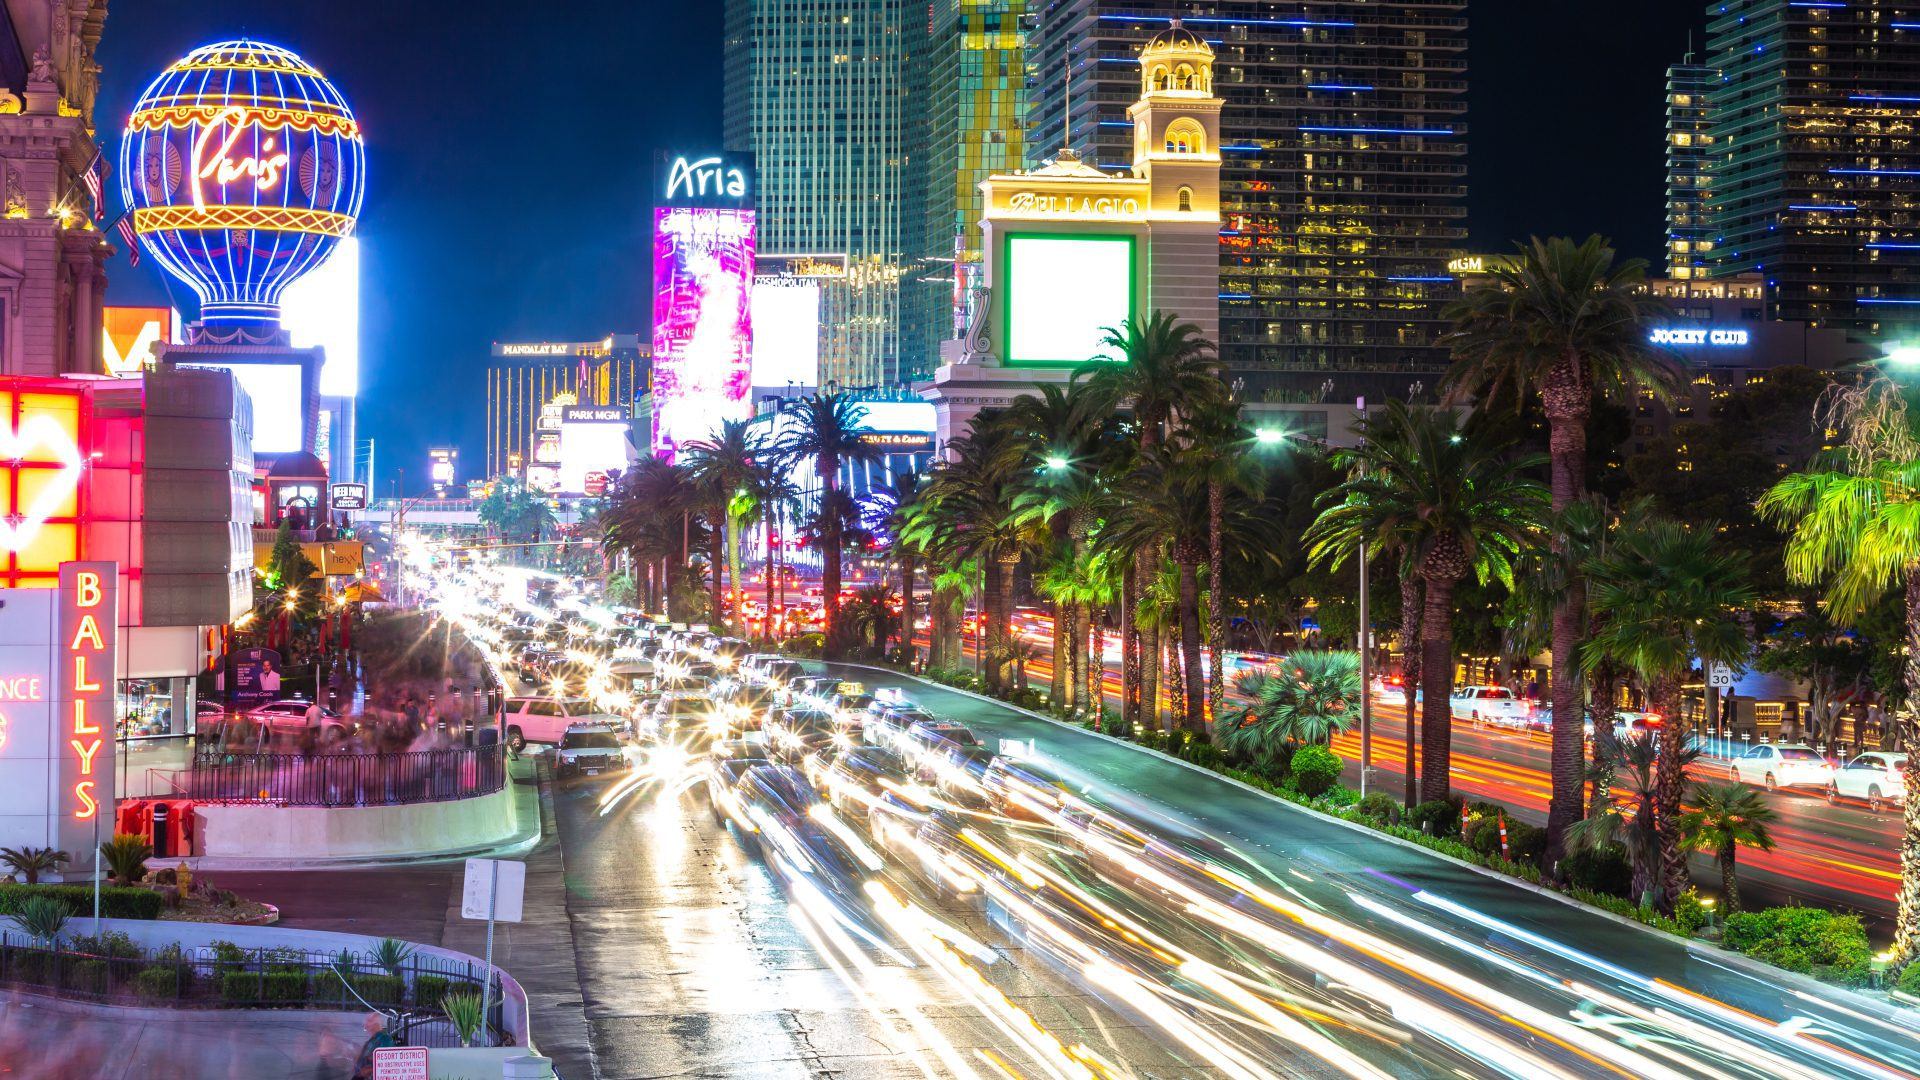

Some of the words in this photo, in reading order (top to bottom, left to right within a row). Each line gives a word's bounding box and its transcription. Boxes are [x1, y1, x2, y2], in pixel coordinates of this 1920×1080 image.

[191, 106, 288, 215] Paris
[666, 157, 745, 199] Aria
[1009, 192, 1140, 214] BELLAGIO
[755, 278, 818, 288] COSMOPOLITAN
[1649, 329, 1707, 343] JOCKEY
[1710, 330, 1748, 344] CLUB
[503, 345, 549, 354] MANDALAY
[551, 345, 567, 354] BAY
[569, 410, 594, 420] PARK
[595, 410, 620, 420] MGM
[1712, 676, 1728, 684] 30
